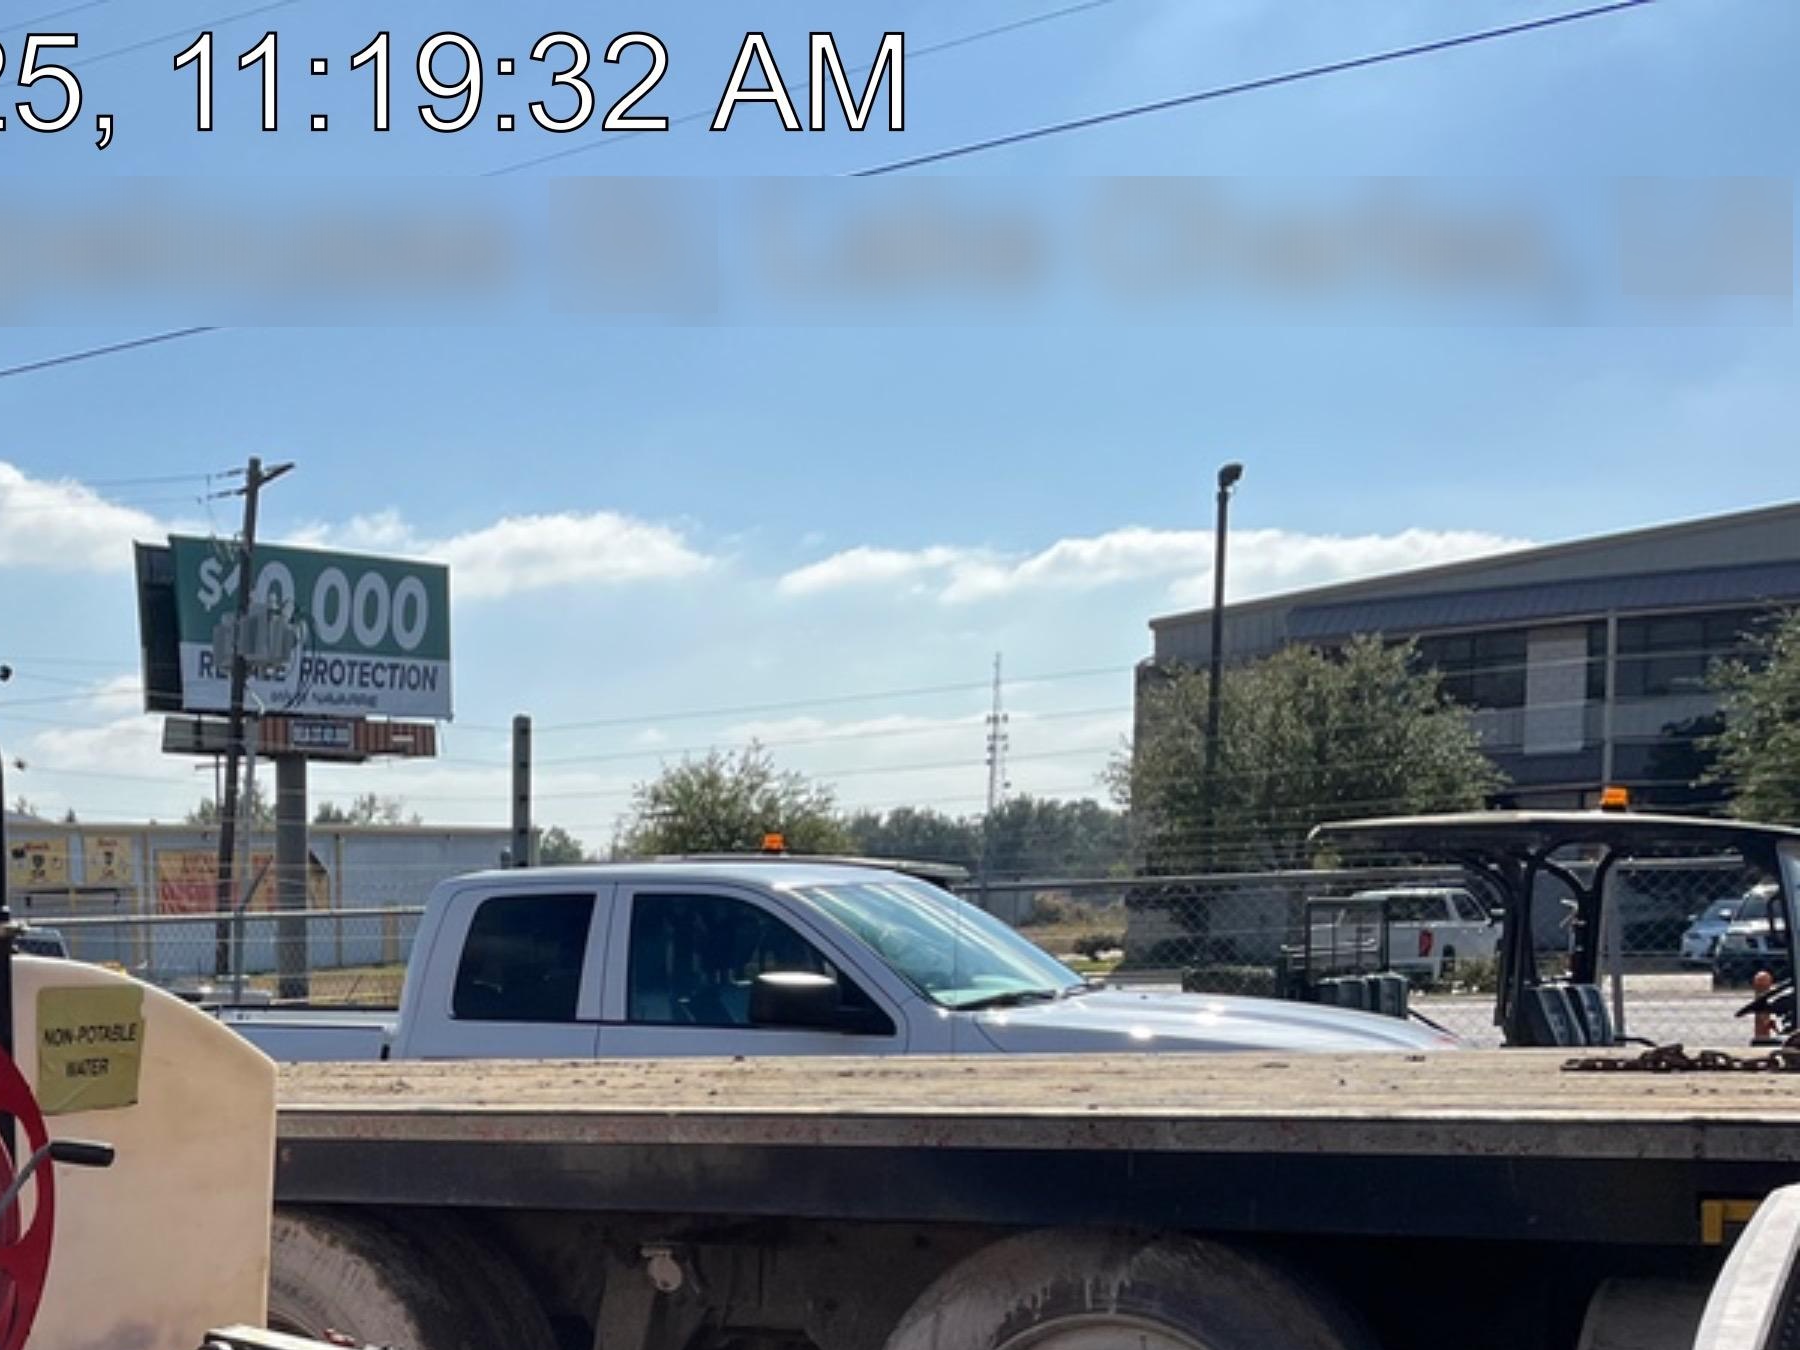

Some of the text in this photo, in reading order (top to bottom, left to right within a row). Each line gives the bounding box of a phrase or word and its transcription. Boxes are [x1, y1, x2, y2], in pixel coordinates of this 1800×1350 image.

[300, 656, 439, 691] PROTECTION
[44, 1022, 137, 1047] NON-POTABLE
[65, 1058, 109, 1077] WATER
